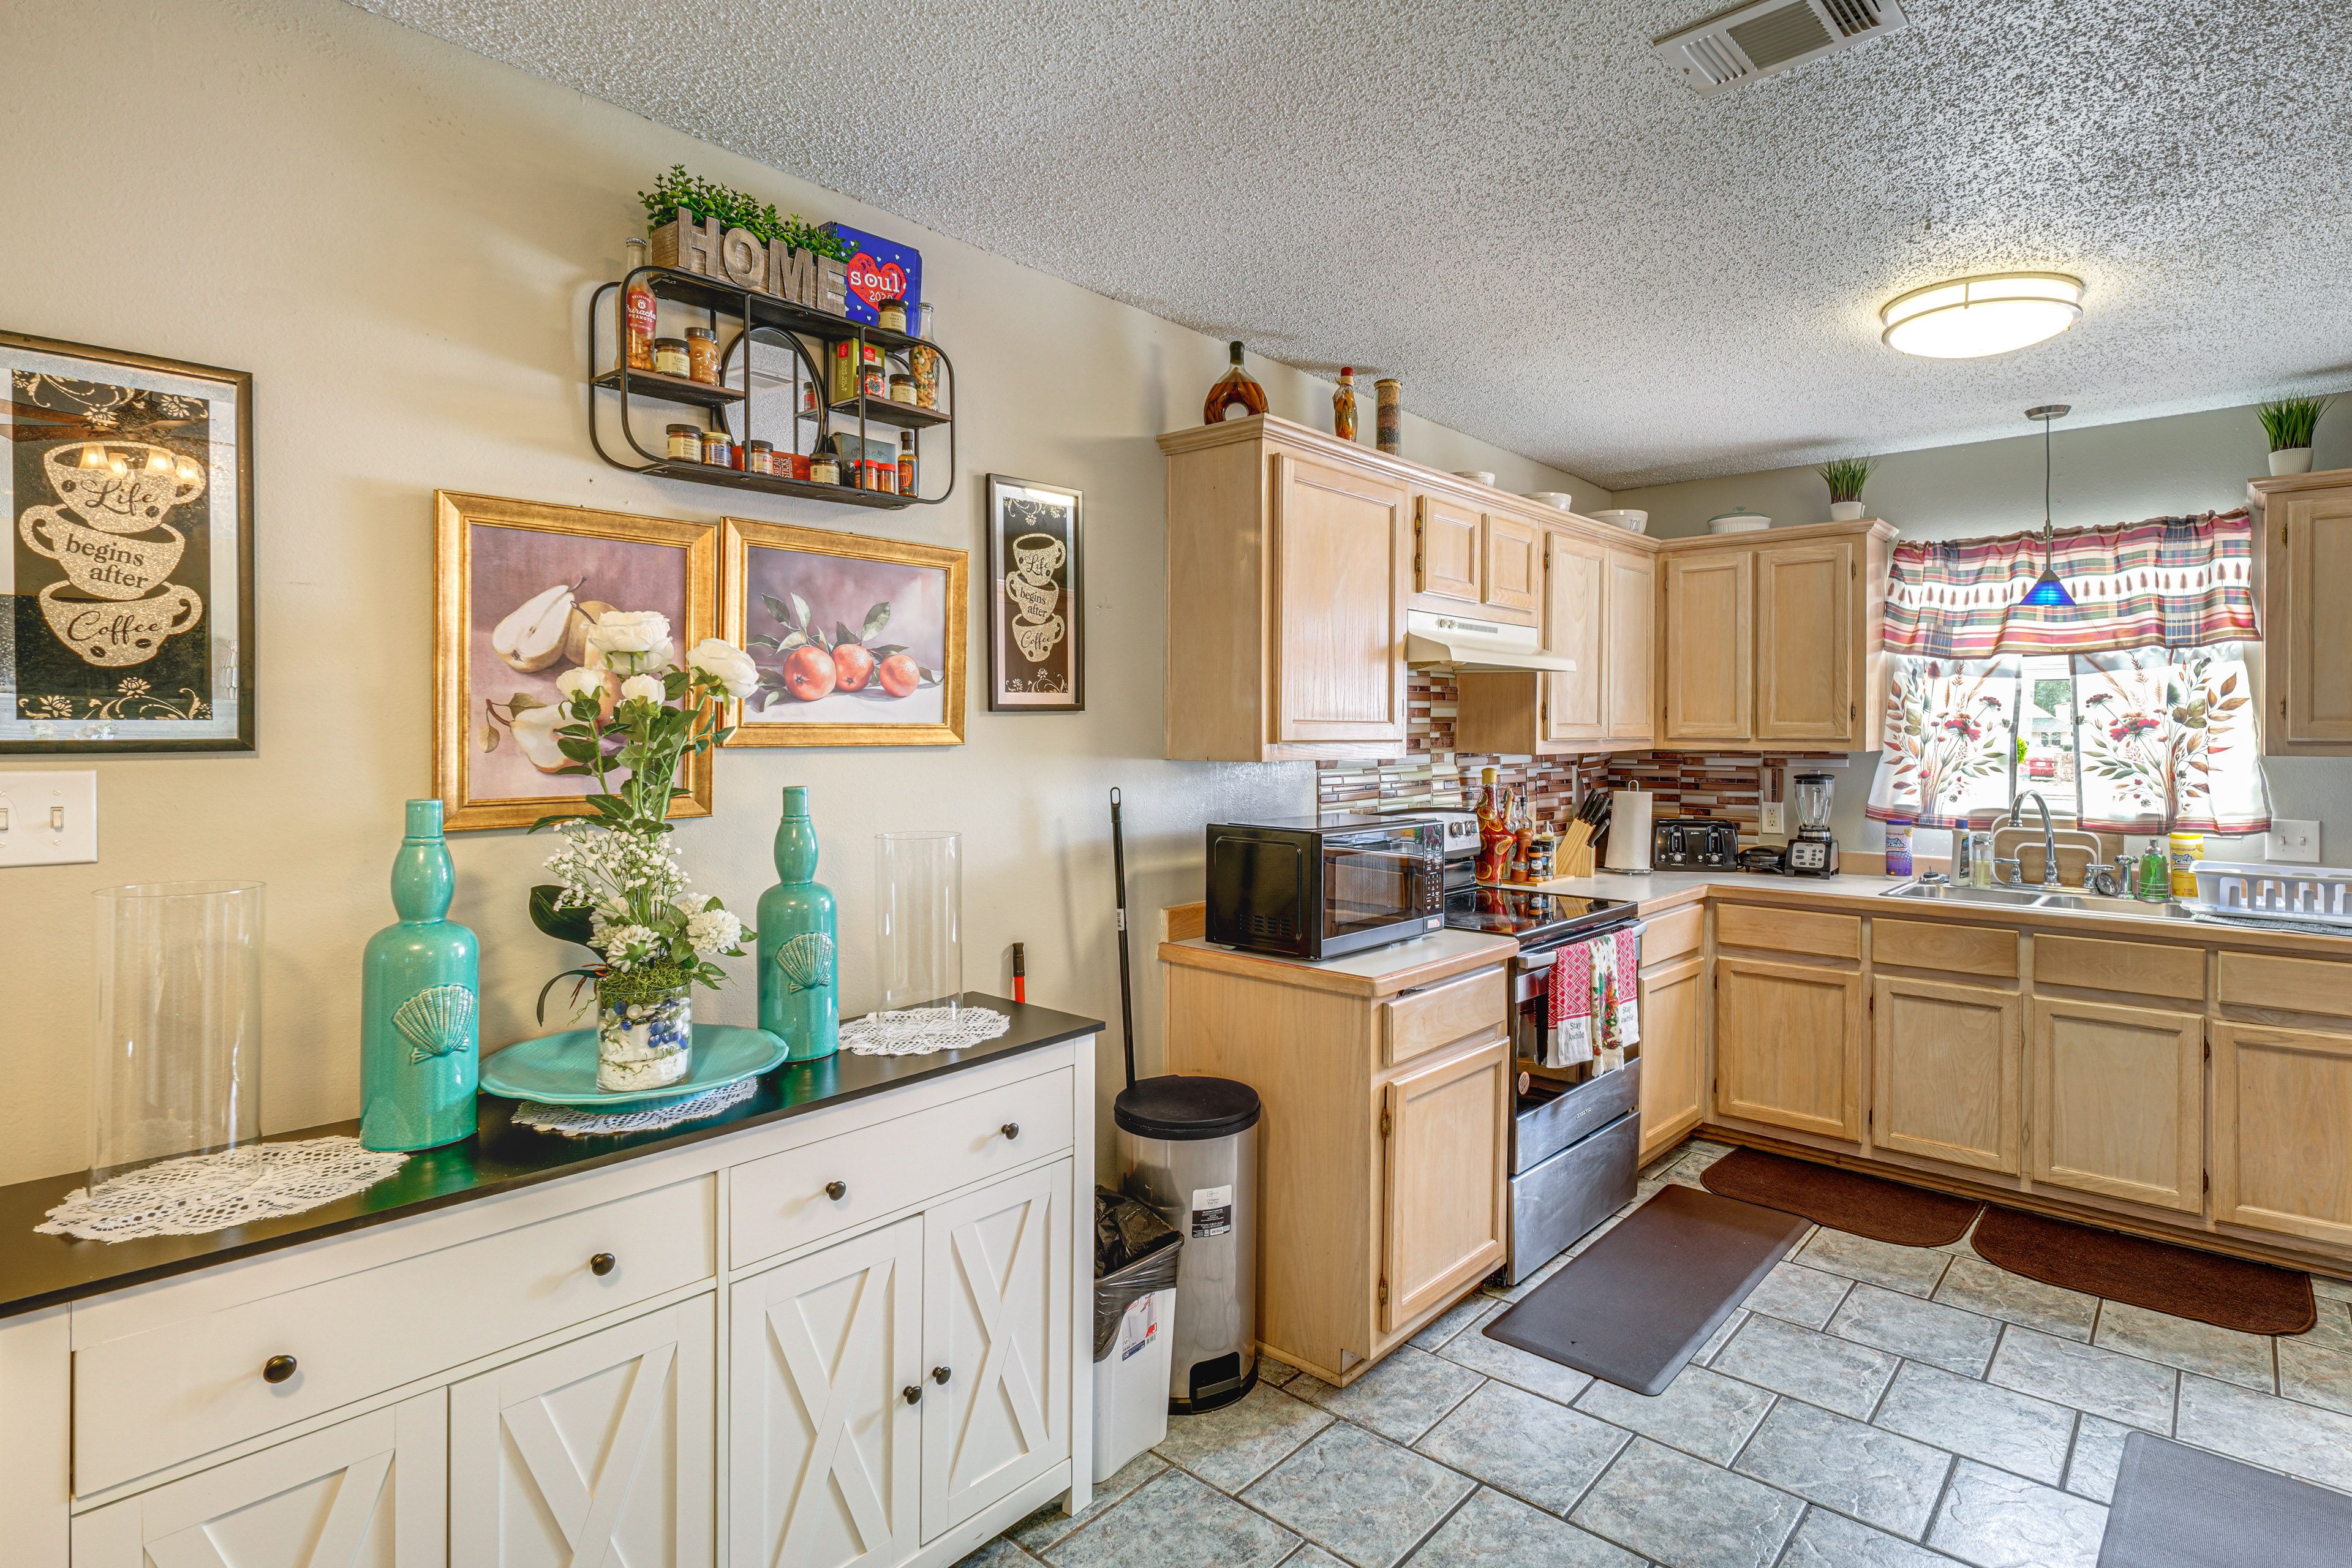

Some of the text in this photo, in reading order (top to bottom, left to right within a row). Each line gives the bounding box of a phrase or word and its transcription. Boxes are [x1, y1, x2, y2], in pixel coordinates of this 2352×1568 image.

[677, 206, 848, 318] HOME
[851, 271, 900, 293] soul
[628, 314, 652, 322] PEANUTS
[781, 458, 790, 478] STICKS
[81, 478, 159, 516] Life
[1629, 519, 1642, 530] TOSS
[66, 533, 145, 567] begins
[1025, 554, 1050, 576] Life
[89, 564, 148, 589] after
[1020, 587, 1046, 605] begins
[1028, 604, 1047, 617] after
[67, 611, 162, 646] Coffee
[1021, 630, 1051, 650] Coffee
[1621, 1014, 1634, 1024] Awhile
[1568, 1031, 1585, 1041] Awhile
